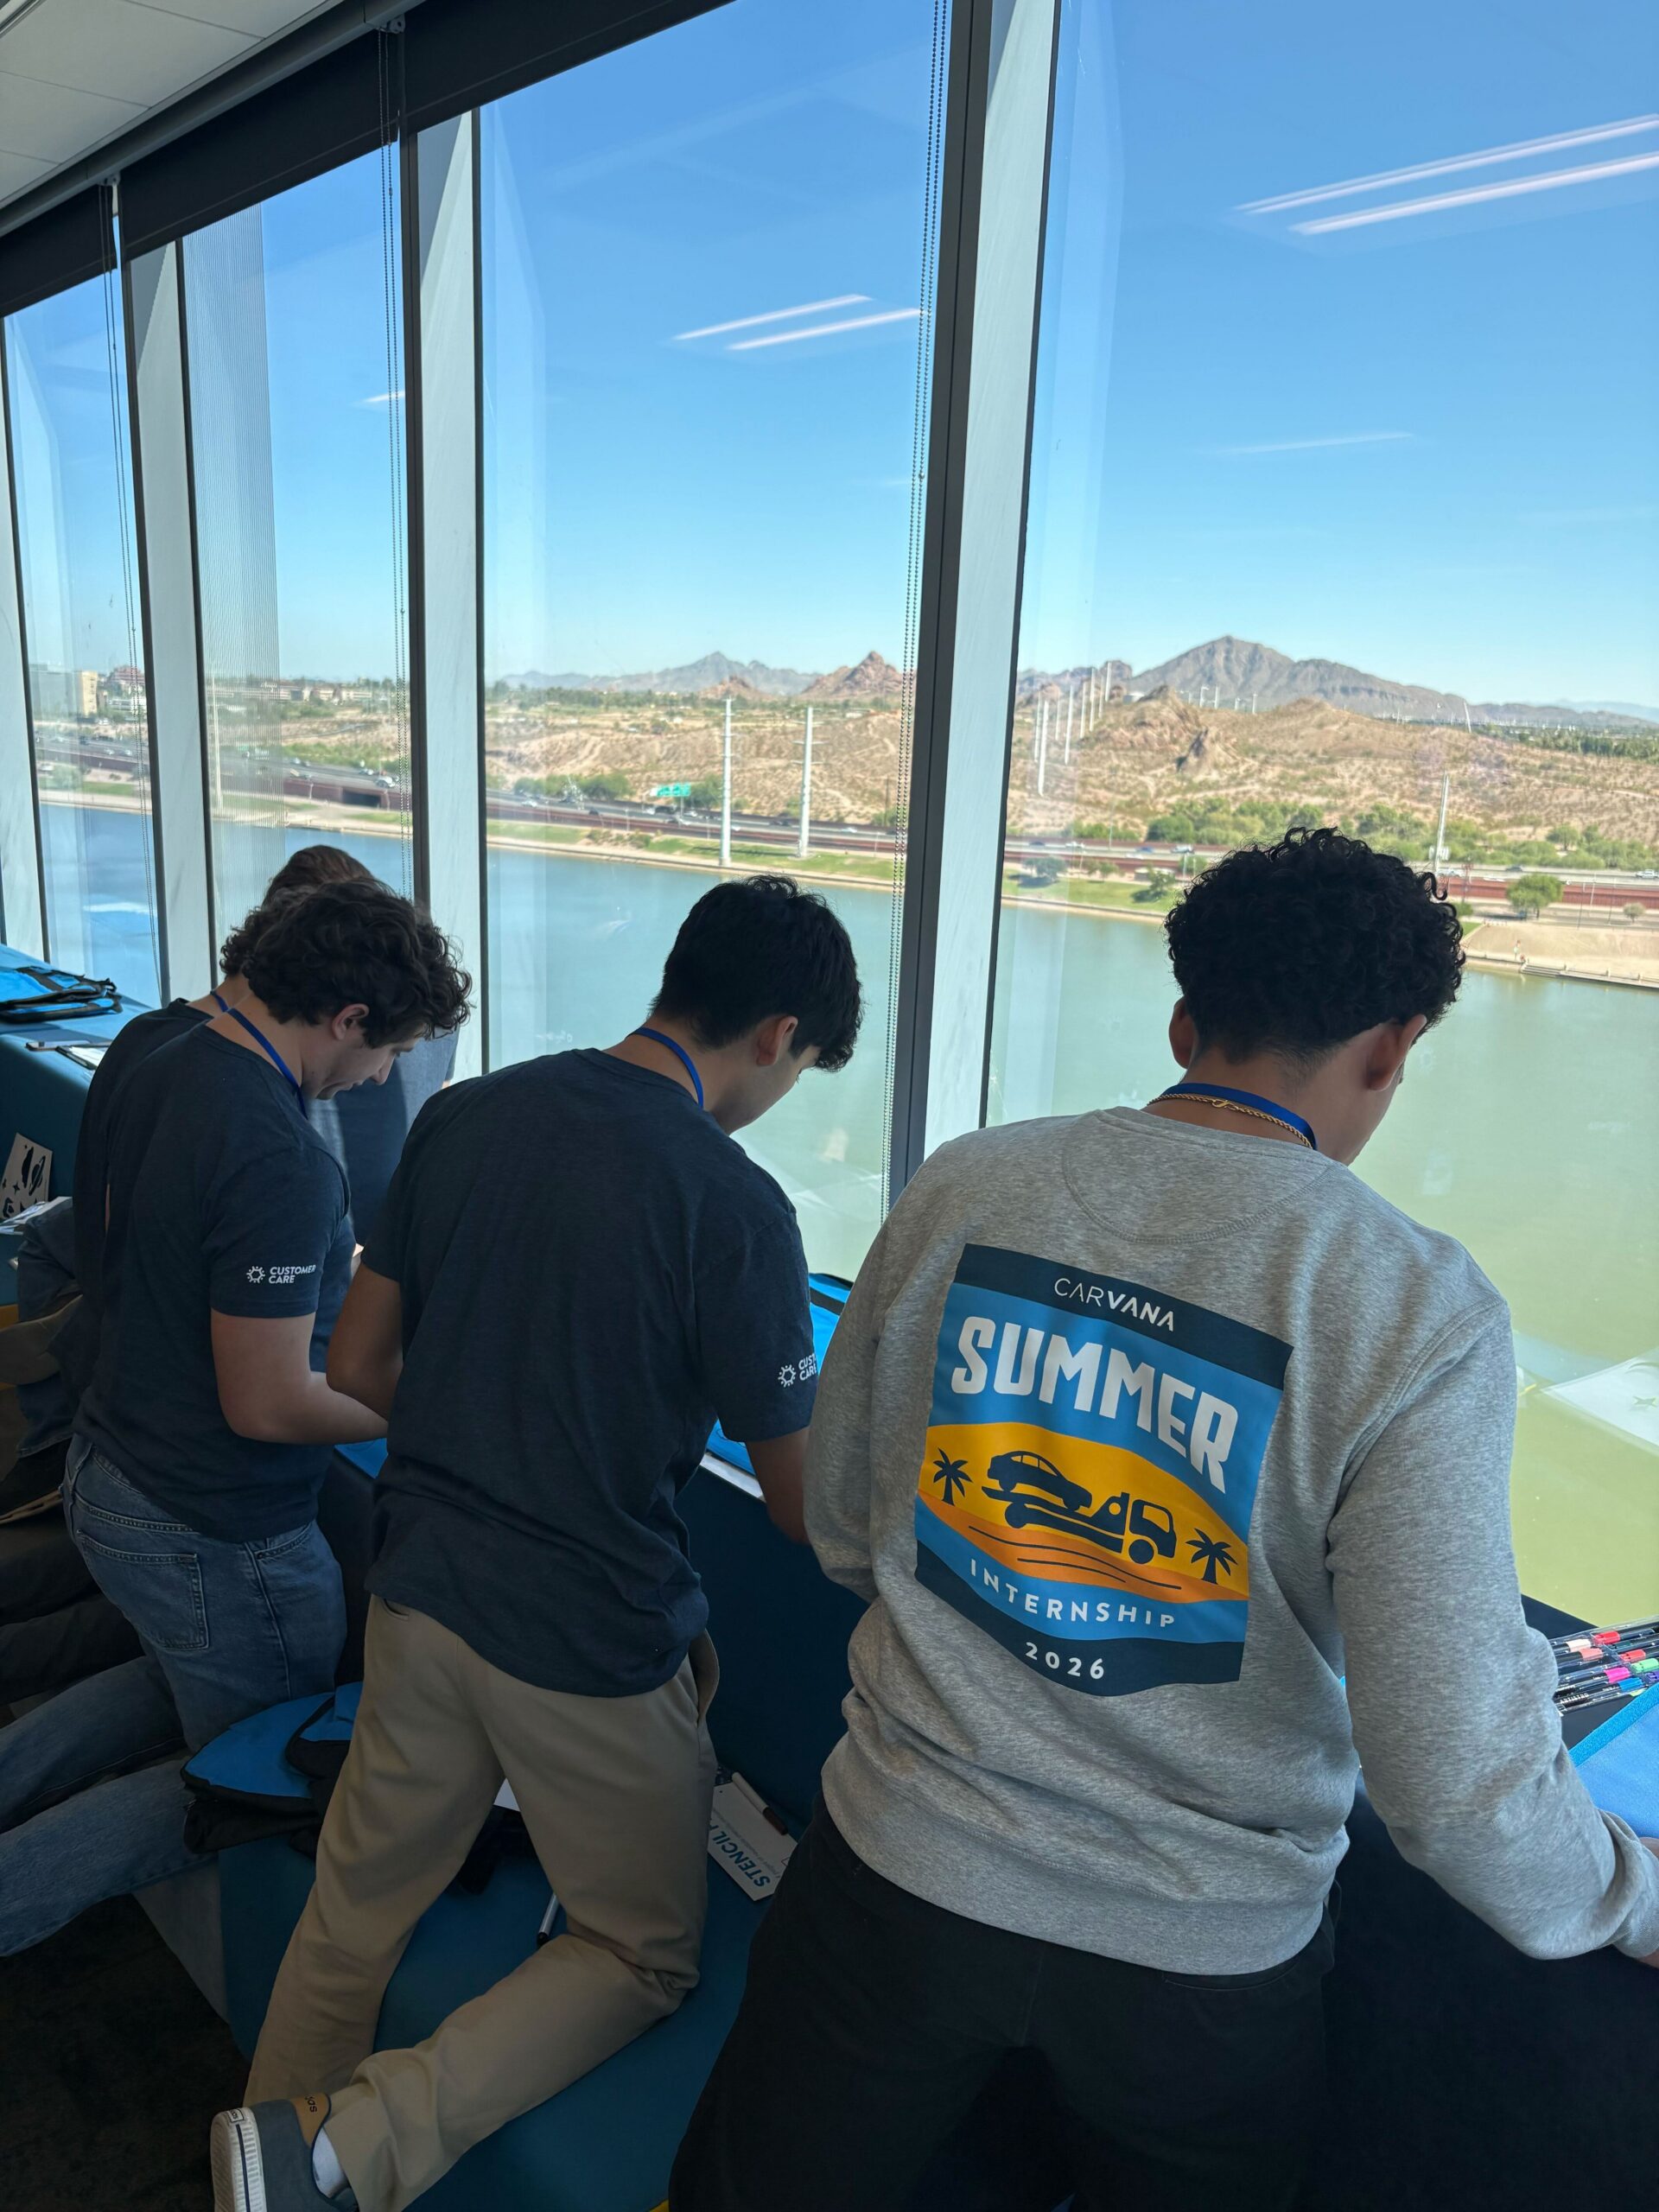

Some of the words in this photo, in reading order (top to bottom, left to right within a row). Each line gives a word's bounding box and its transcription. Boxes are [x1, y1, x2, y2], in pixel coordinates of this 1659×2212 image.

[268, 1274, 296, 1284] CARE
[270, 1264, 316, 1274] CUSTOMER
[1054, 1278, 1174, 1332] CARVANA
[798, 1353, 817, 1370] CUST
[951, 1317, 1238, 1494] SUMMER
[970, 1559, 1174, 1628] INTERNSHIP
[1025, 1642, 1104, 1679] 2026
[712, 1831, 771, 1887] STENCIL
